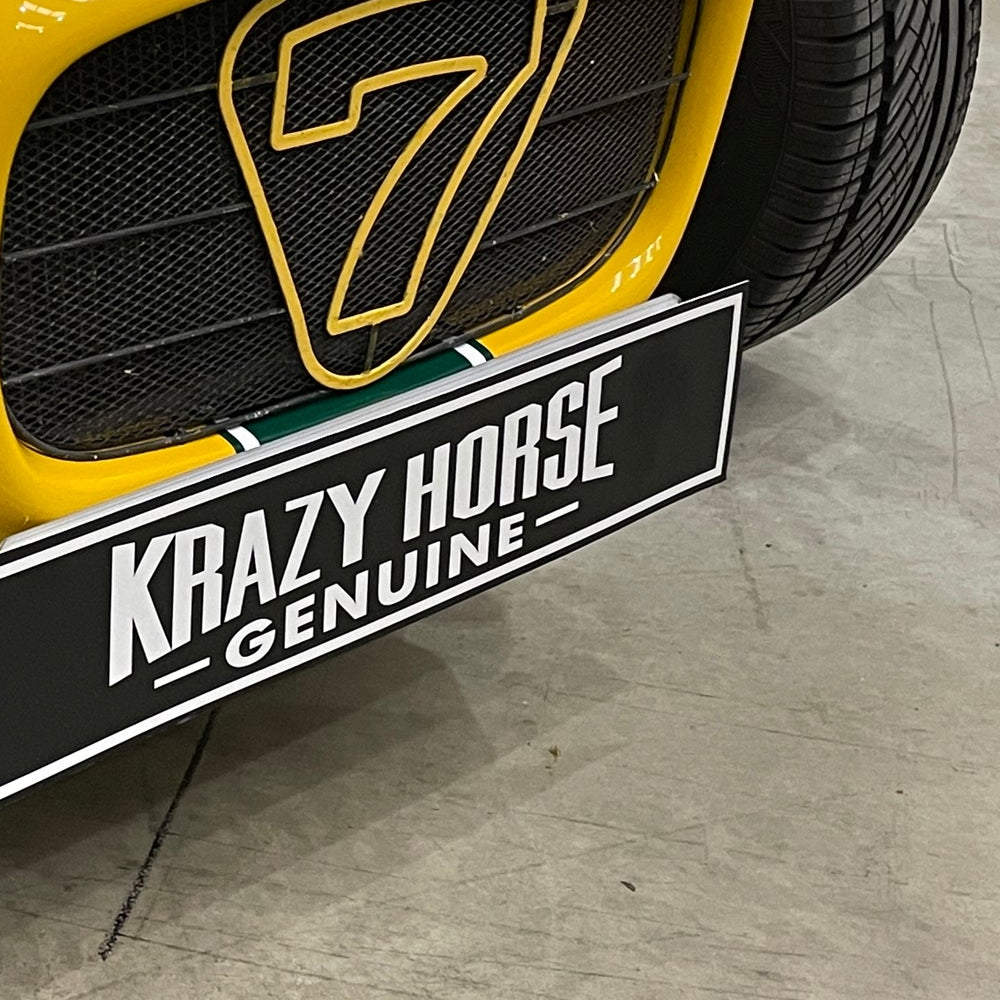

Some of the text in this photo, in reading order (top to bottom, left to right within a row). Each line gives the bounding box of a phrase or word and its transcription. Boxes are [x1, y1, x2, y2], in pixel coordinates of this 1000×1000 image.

[108, 355, 623, 686] KRAZY HORSE
[225, 511, 525, 670] GENUINE
